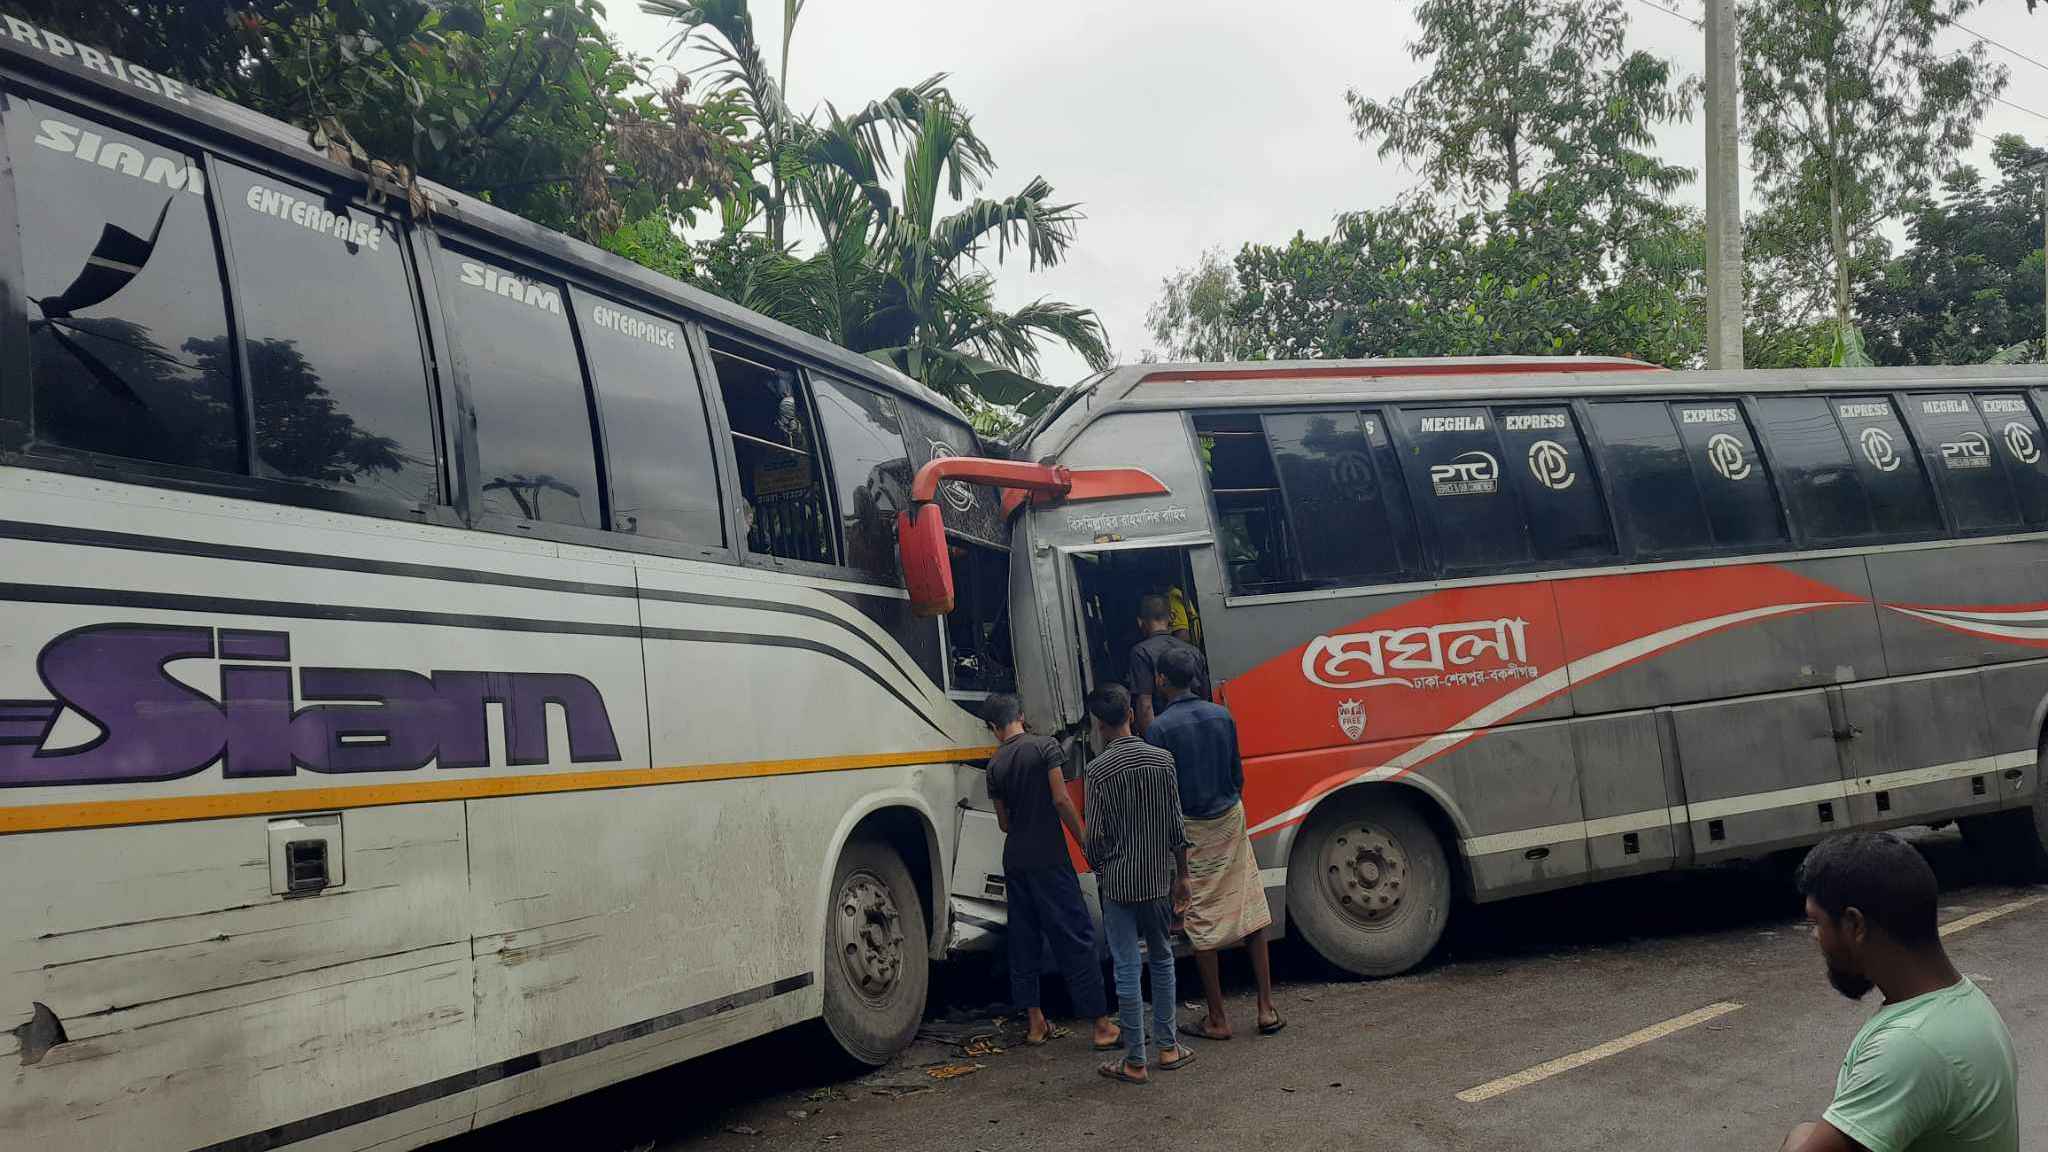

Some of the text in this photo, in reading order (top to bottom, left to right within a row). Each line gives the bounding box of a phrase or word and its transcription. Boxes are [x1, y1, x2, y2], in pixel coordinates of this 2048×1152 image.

[0, 14, 191, 106] RPRISE
[34, 119, 382, 251] SIAM ENTERPRISE
[460, 262, 675, 349] SIAM ENTERPRISE
[1683, 408, 1737, 423] EXPRESS
[1840, 404, 1889, 417] EXPRESS
[1922, 400, 2027, 413] MEGHLA EXPRESS
[1421, 414, 1565, 432] MEGHLA EXPRESS
[1941, 441, 1986, 457] PTC
[1430, 462, 1492, 482] PTC
[1302, 616, 1530, 689] মেঘলা
[0, 621, 622, 788] Siam
